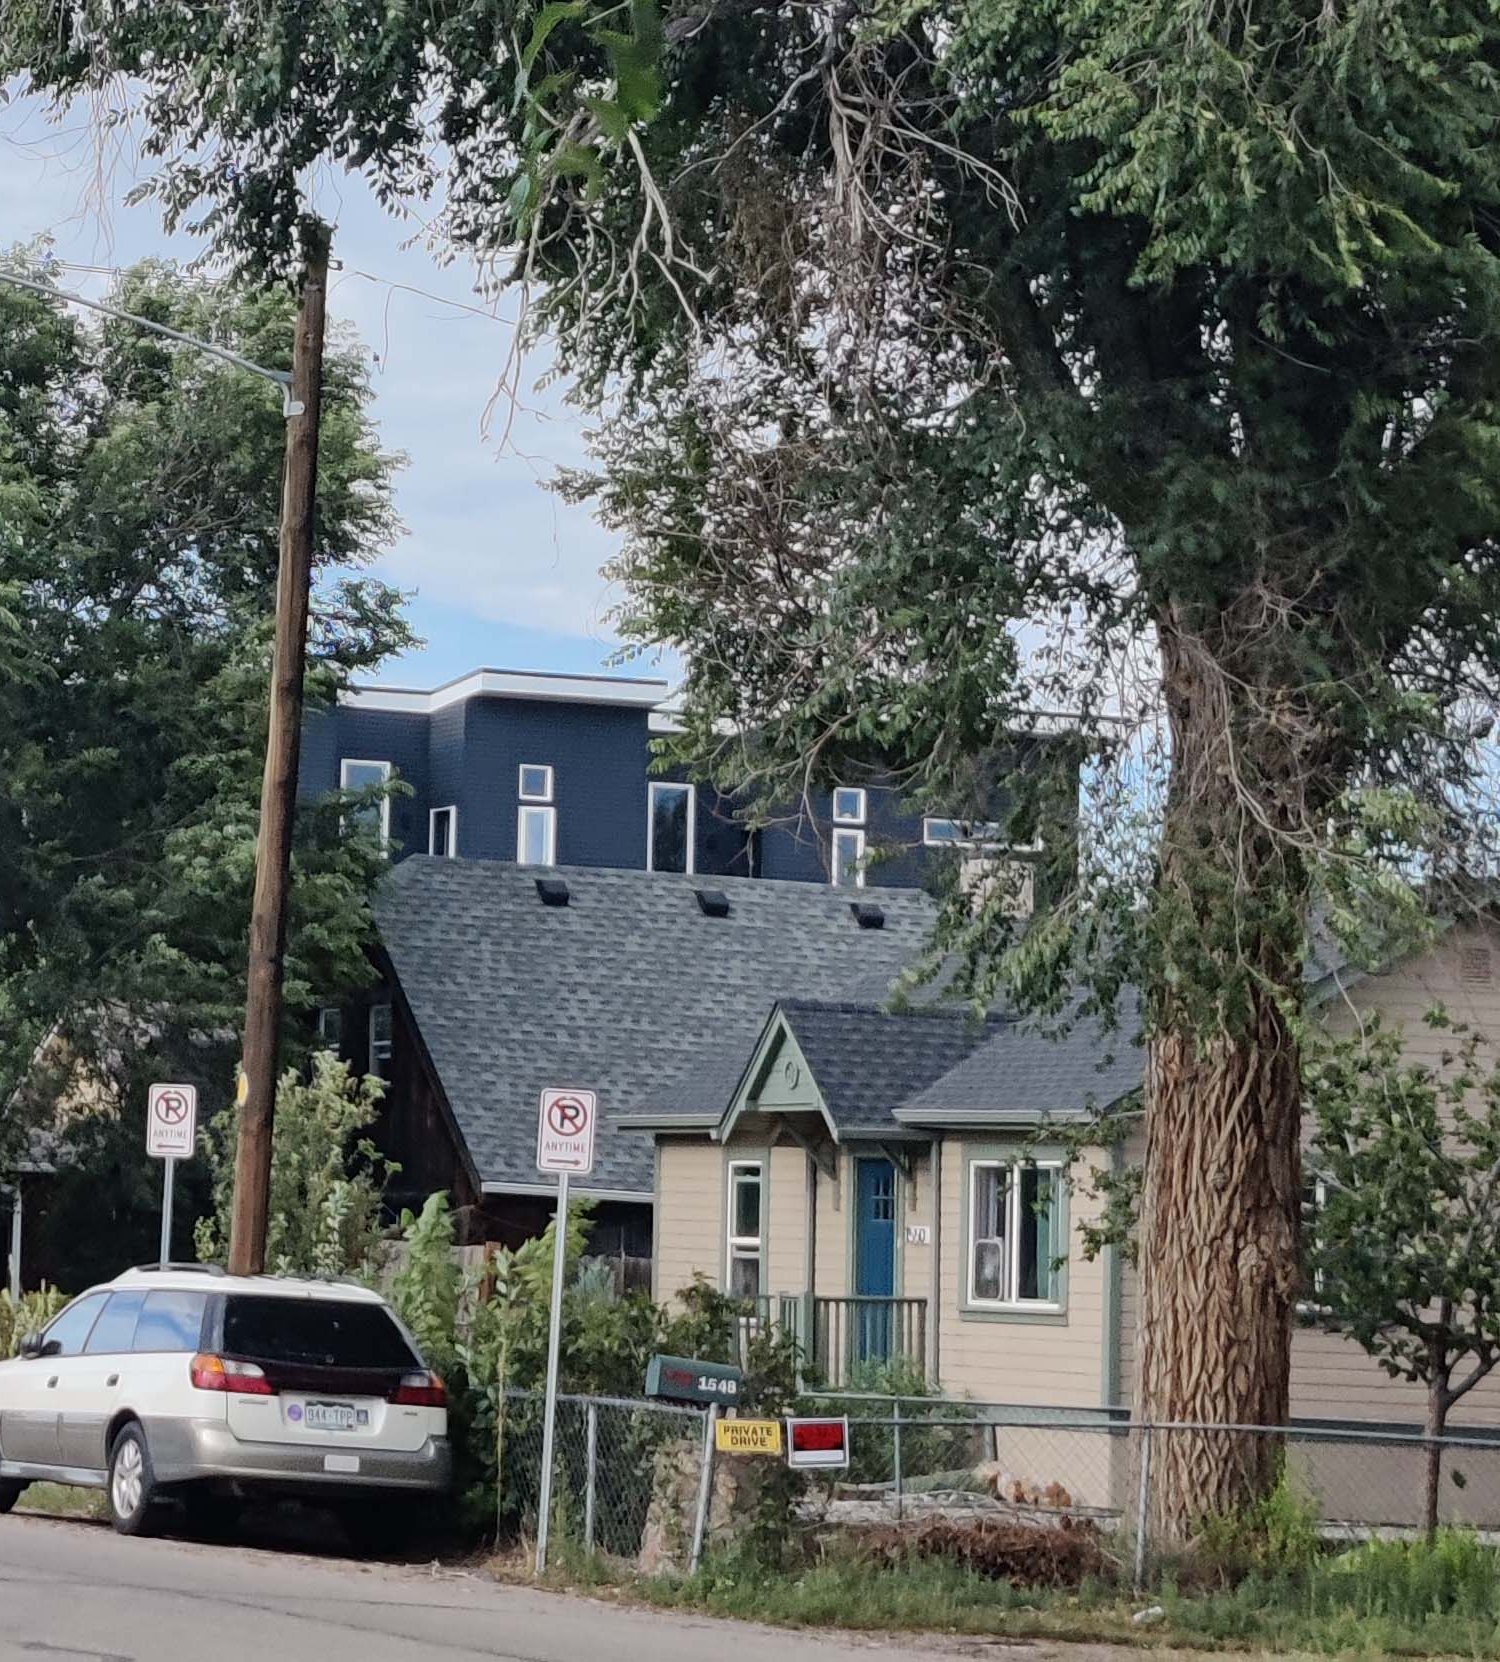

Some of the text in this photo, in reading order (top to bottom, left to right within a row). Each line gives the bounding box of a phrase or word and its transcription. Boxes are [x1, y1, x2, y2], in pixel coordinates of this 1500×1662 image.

[153, 1128, 187, 1139] ANYTIME
[545, 1141, 586, 1153] ANYTIME
[698, 1376, 737, 1394] 1548
[723, 1425, 772, 1437] PRIVATE
[731, 1435, 767, 1447] DRIVE
